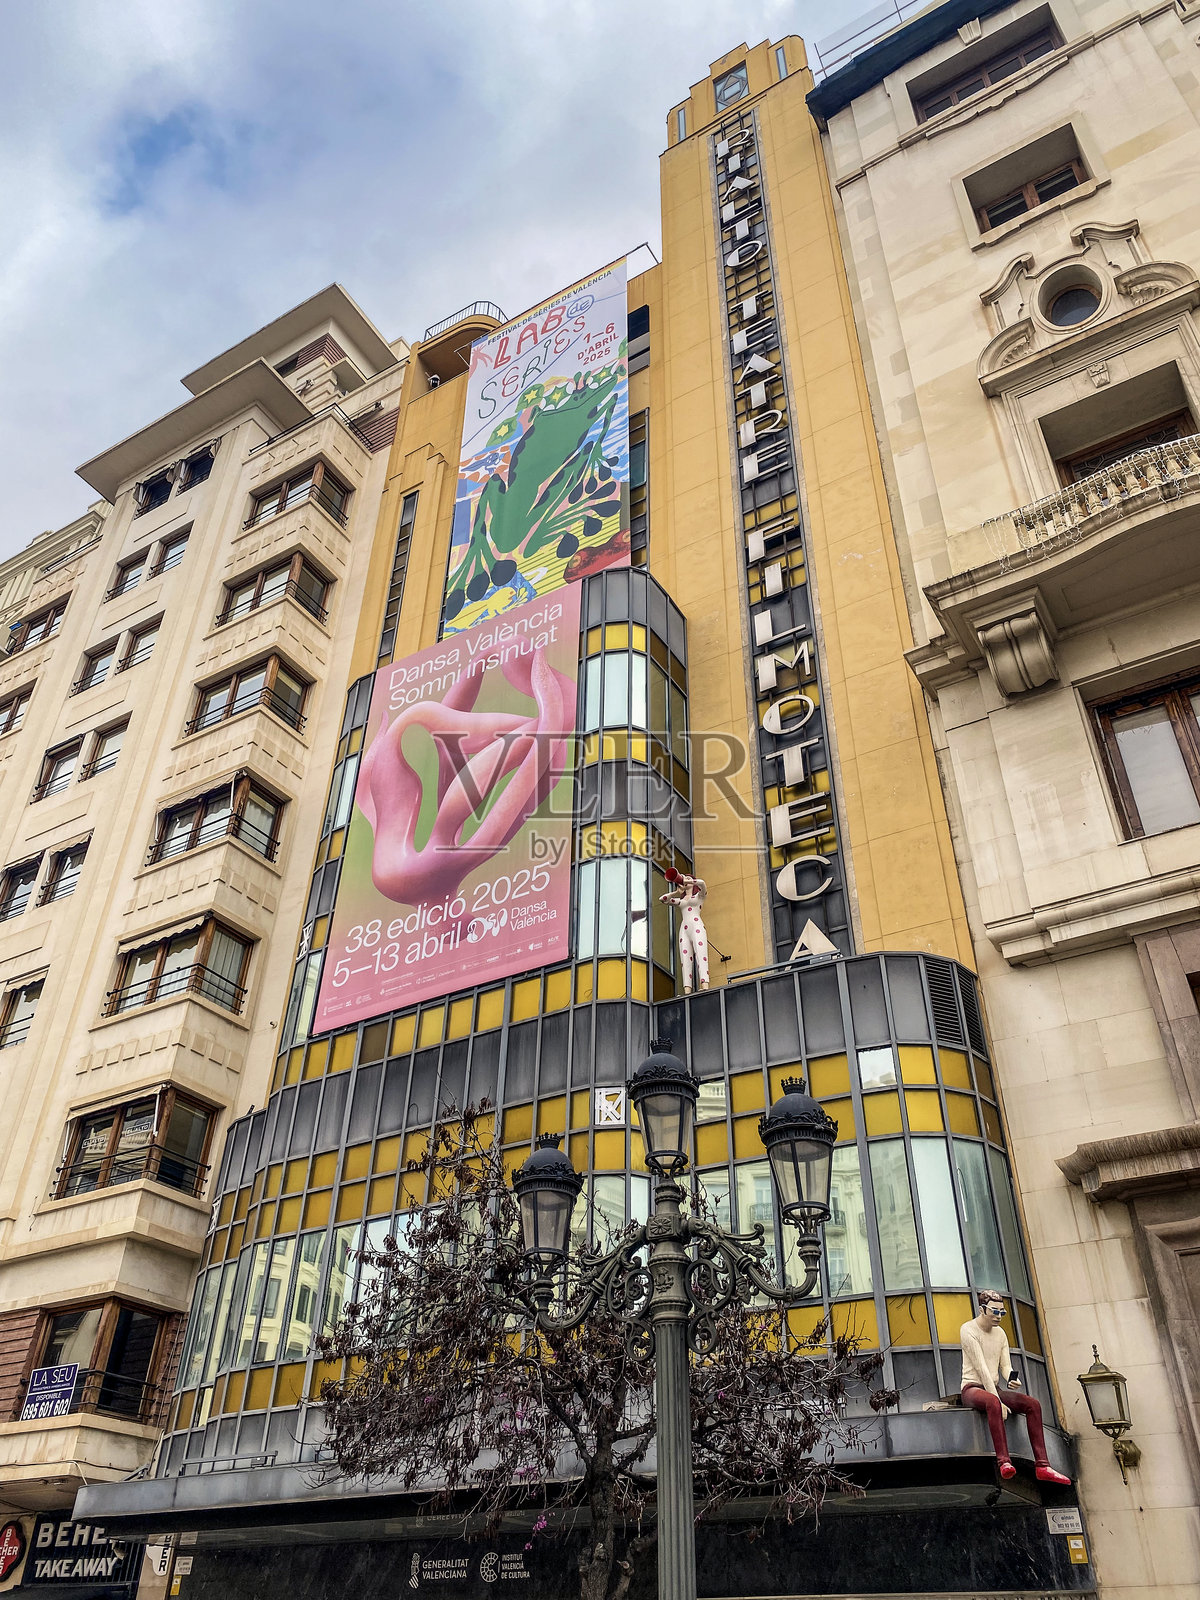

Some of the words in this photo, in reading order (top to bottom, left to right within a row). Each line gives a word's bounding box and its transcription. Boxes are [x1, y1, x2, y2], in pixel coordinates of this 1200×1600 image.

[716, 128, 763, 268] RIALTO
[487, 322, 522, 345] FESTIVAL
[522, 316, 533, 325] DE
[561, 293, 572, 303] DE
[572, 270, 612, 295] VALÈNCIA
[577, 332, 620, 361] D'ABRIL
[582, 347, 611, 366] 2025
[730, 289, 789, 484] TEATRE
[388, 647, 460, 691] Dansa
[465, 602, 563, 656] València
[388, 664, 461, 711] Somni
[466, 624, 558, 680] insinuat
[747, 516, 841, 971] FILMOTECA
[344, 918, 383, 954] 38
[386, 890, 467, 940] edició
[471, 861, 551, 913] 2025
[509, 908, 557, 933] València
[510, 899, 548, 920] Dansa
[404, 920, 463, 966] abril
[33, 1371, 47, 1387] LA
[51, 1366, 75, 1384] SEU
[23, 1402, 40, 1420] 695
[38, 1400, 54, 1418] 601
[53, 1398, 69, 1416] 602
[36, 1391, 62, 1402] DISPONIBLE
[35, 1521, 108, 1548] BEHE
[422, 1558, 470, 1569] GENERALITAT
[501, 1553, 523, 1561] INSTITUT
[422, 1570, 467, 1580] VALENCIANA
[508, 1571, 530, 1579] CULTURA
